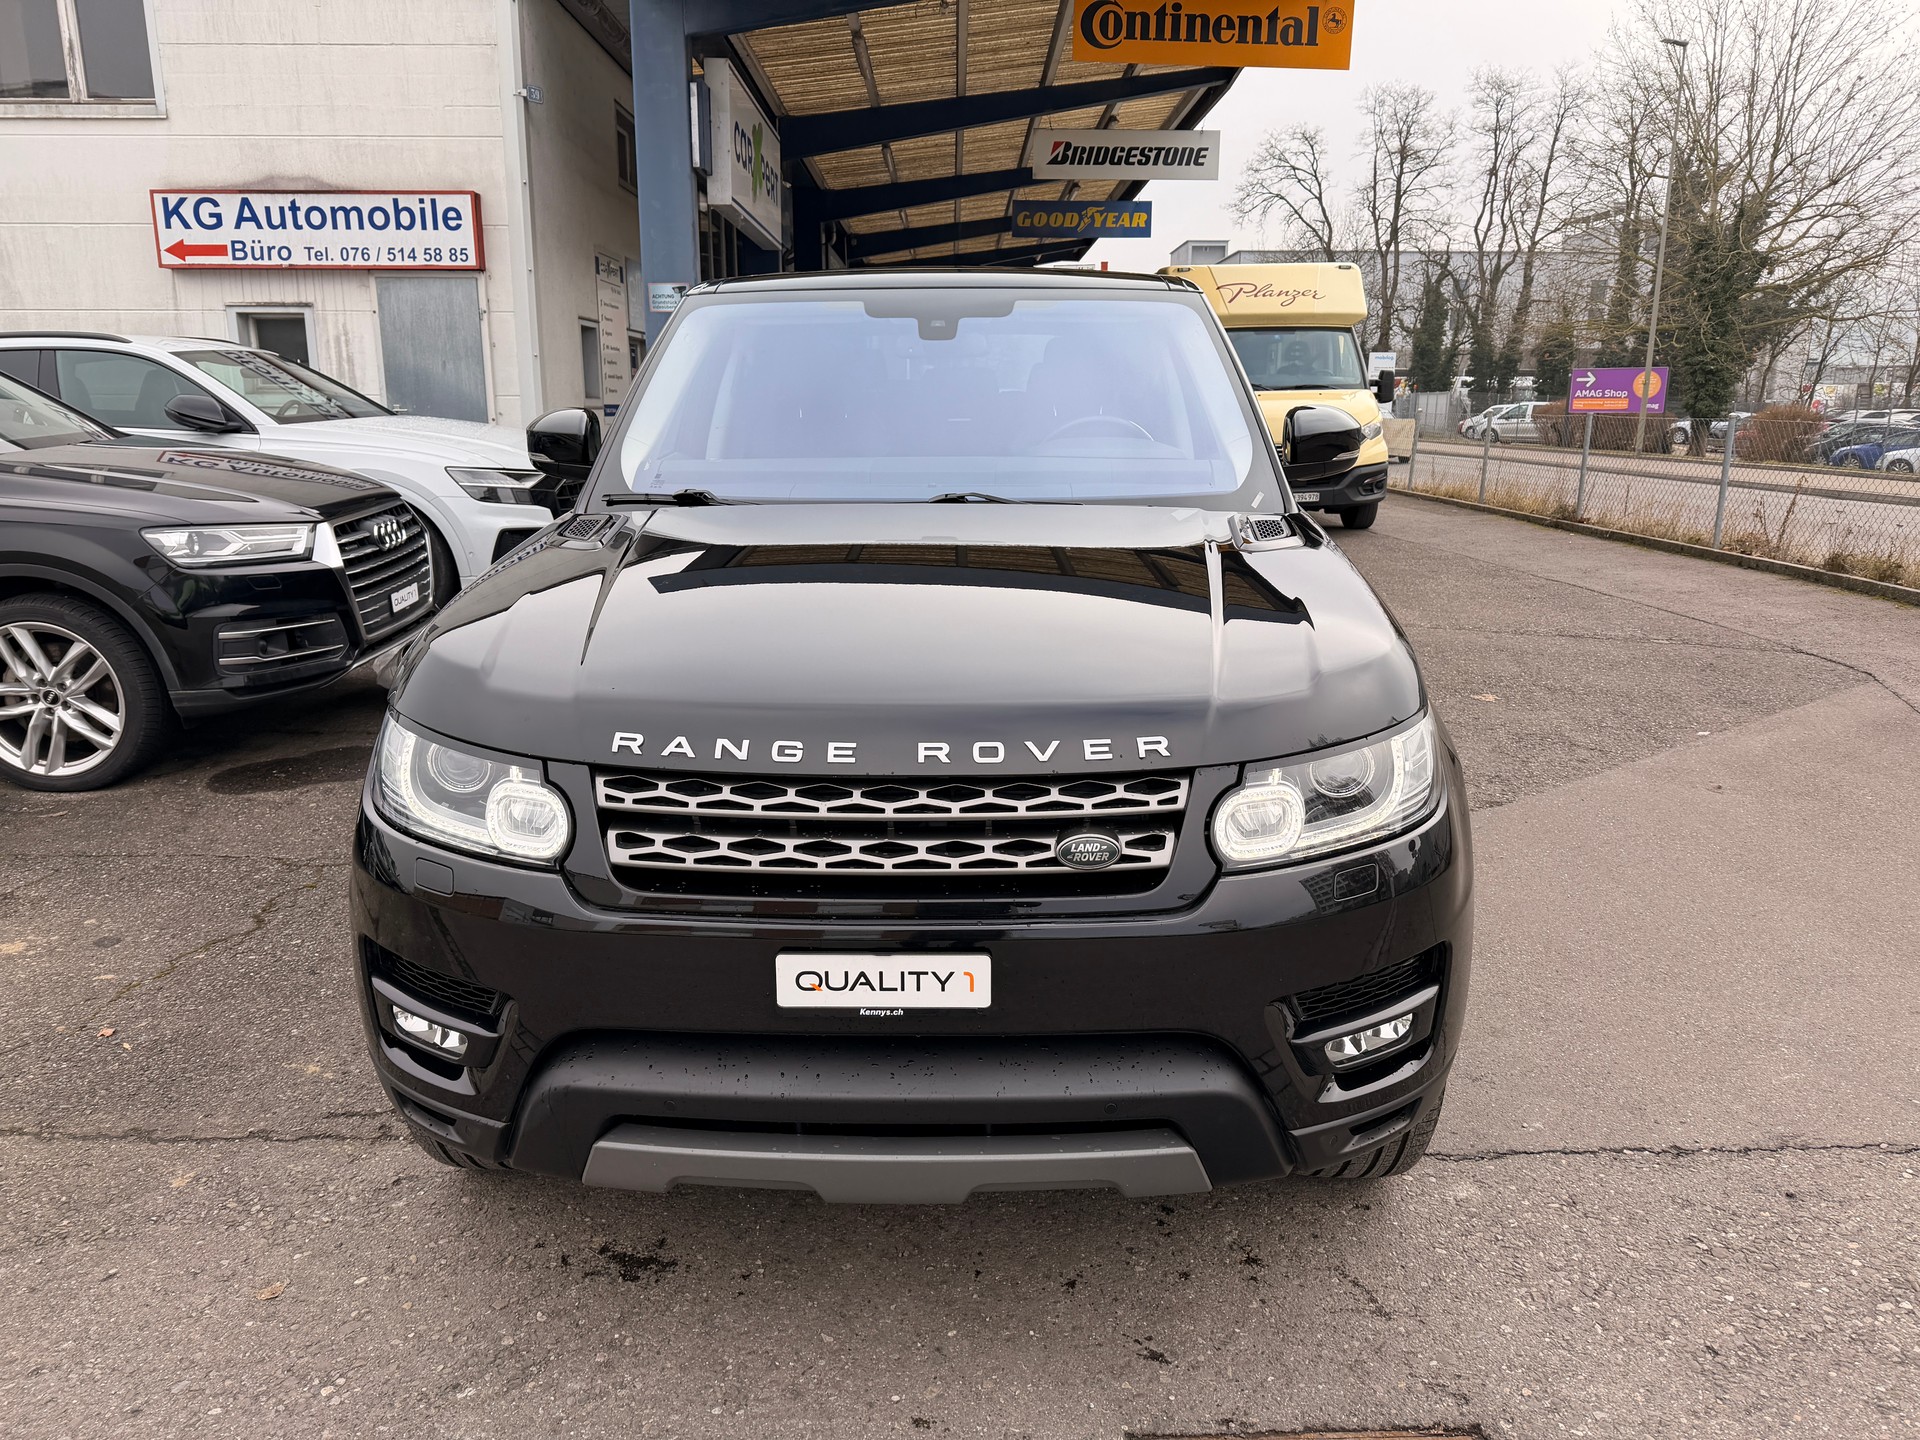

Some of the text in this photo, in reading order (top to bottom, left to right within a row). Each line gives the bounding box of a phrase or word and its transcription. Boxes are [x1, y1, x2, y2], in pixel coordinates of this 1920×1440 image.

[1080, 0, 1320, 49] Continental
[1046, 140, 1210, 166] BRIDGESTONE
[161, 196, 463, 231] KG Automobile
[230, 239, 293, 262] Büro
[304, 246, 335, 262] Tel.
[340, 247, 371, 262] 076
[387, 247, 418, 262] 514
[423, 248, 443, 262] 58
[449, 248, 469, 263] 85
[1216, 282, 1326, 307] Planzer
[1575, 389, 1628, 398] AMAG Shop
[610, 731, 1172, 764] RANGE ROVER
[1070, 843, 1100, 852] LAND
[1072, 852, 1110, 862] ROVER
[795, 970, 955, 992] QUALITY
[859, 1007, 904, 1017] Kennys.ch
